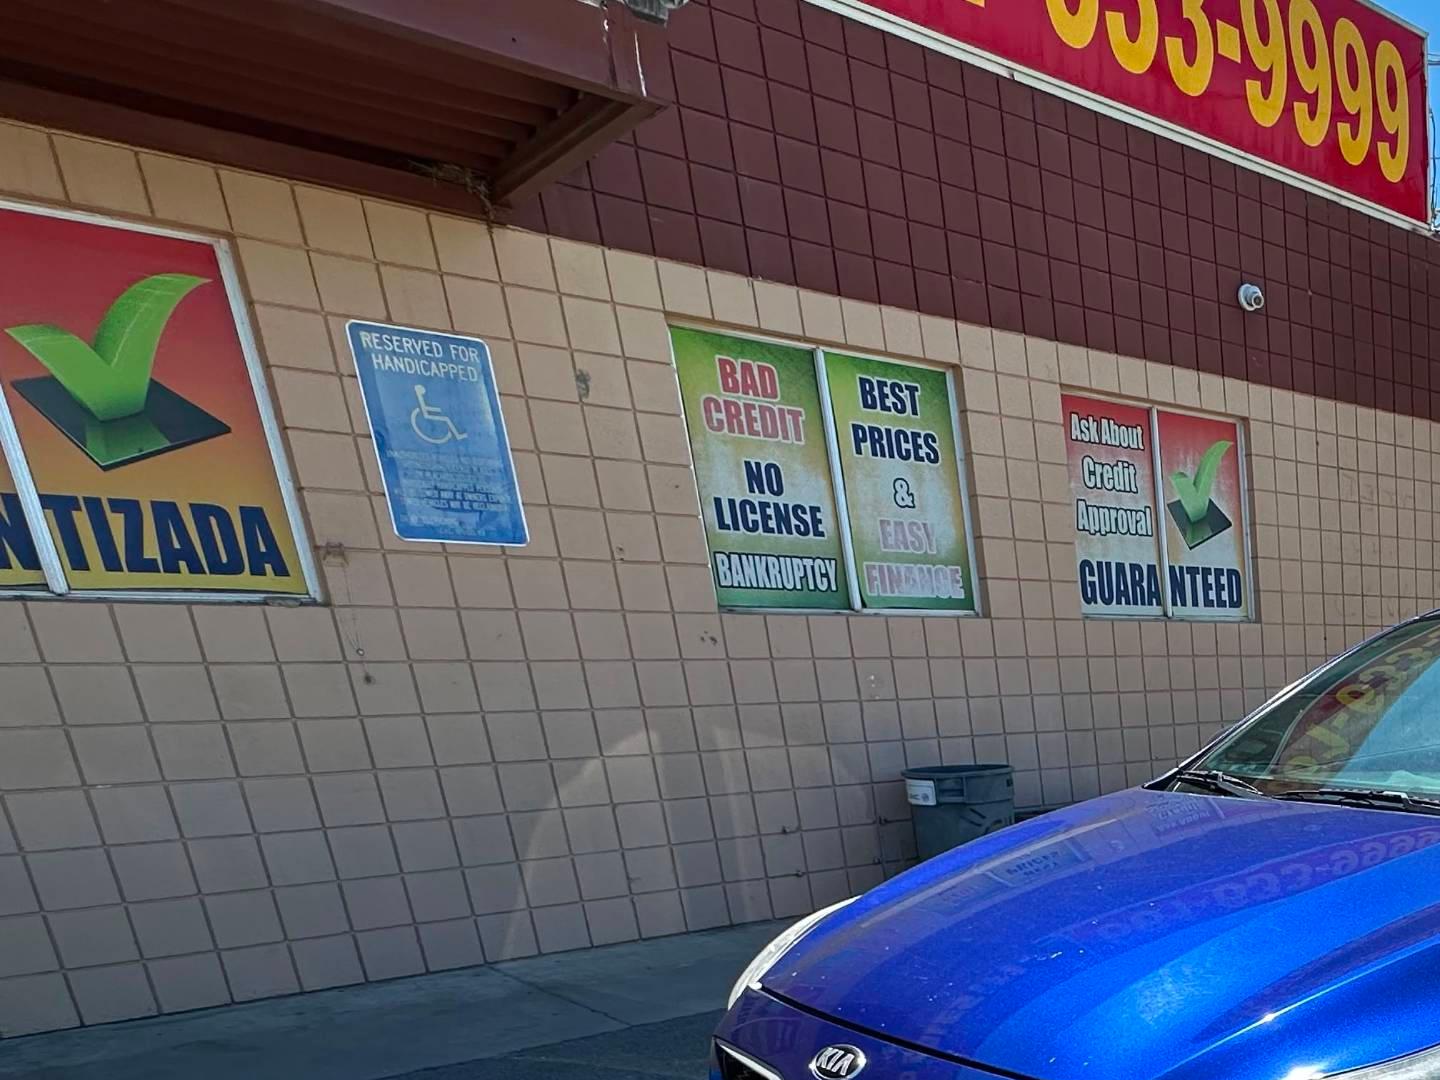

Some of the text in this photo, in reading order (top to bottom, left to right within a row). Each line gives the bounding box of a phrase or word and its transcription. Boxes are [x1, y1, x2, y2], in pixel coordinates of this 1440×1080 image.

[1045, 0, 1410, 183] 3-9999
[359, 330, 481, 363] RESERVED FOR
[371, 353, 478, 382] HANDICAPPED
[716, 356, 779, 400] BAD
[858, 376, 920, 416] BEST
[702, 397, 805, 443] CREDIT
[1070, 412, 1144, 450] Ask About
[851, 423, 940, 464] PRICES
[743, 459, 785, 497] NO
[893, 477, 916, 508] &
[1081, 455, 1138, 494] Credit
[713, 496, 826, 538] LICENSE
[879, 518, 938, 554] EASY
[1076, 499, 1153, 537] Approval
[714, 551, 838, 592] BANKRUPTCY
[864, 562, 965, 600] FINANCE
[1079, 558, 1242, 609] GUARANTEED
[816, 1047, 855, 1076] KIA
